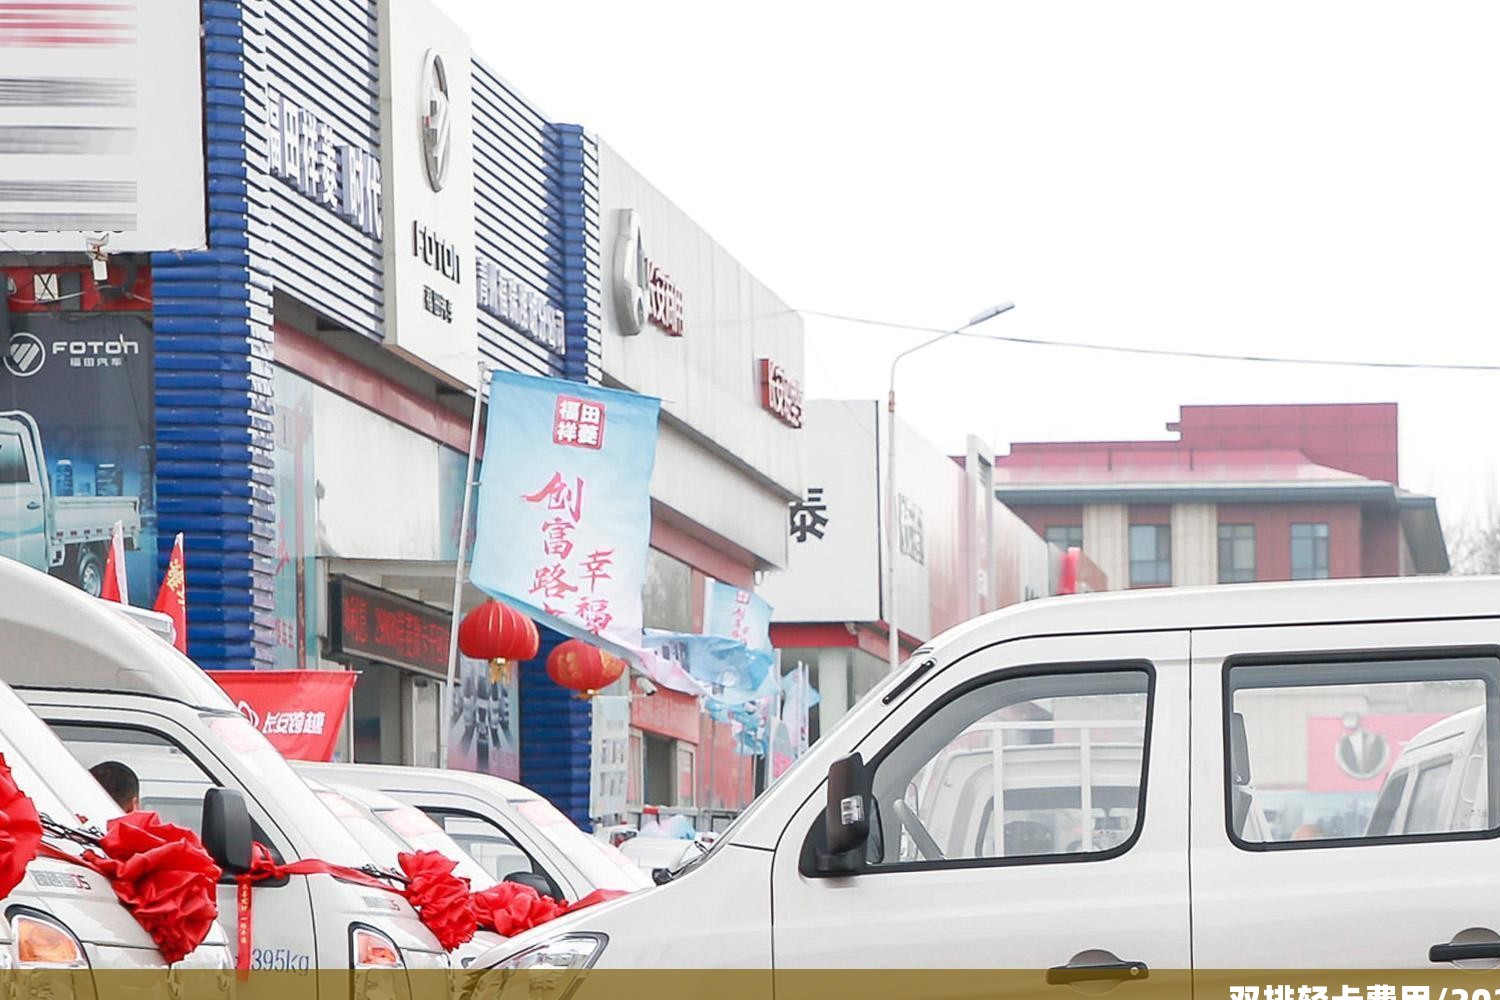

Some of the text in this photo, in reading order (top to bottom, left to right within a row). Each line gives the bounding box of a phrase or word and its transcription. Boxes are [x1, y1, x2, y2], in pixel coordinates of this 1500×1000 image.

[52, 333, 139, 355] FOTON
[559, 399, 601, 424] 福田
[576, 549, 615, 637] 幸福
